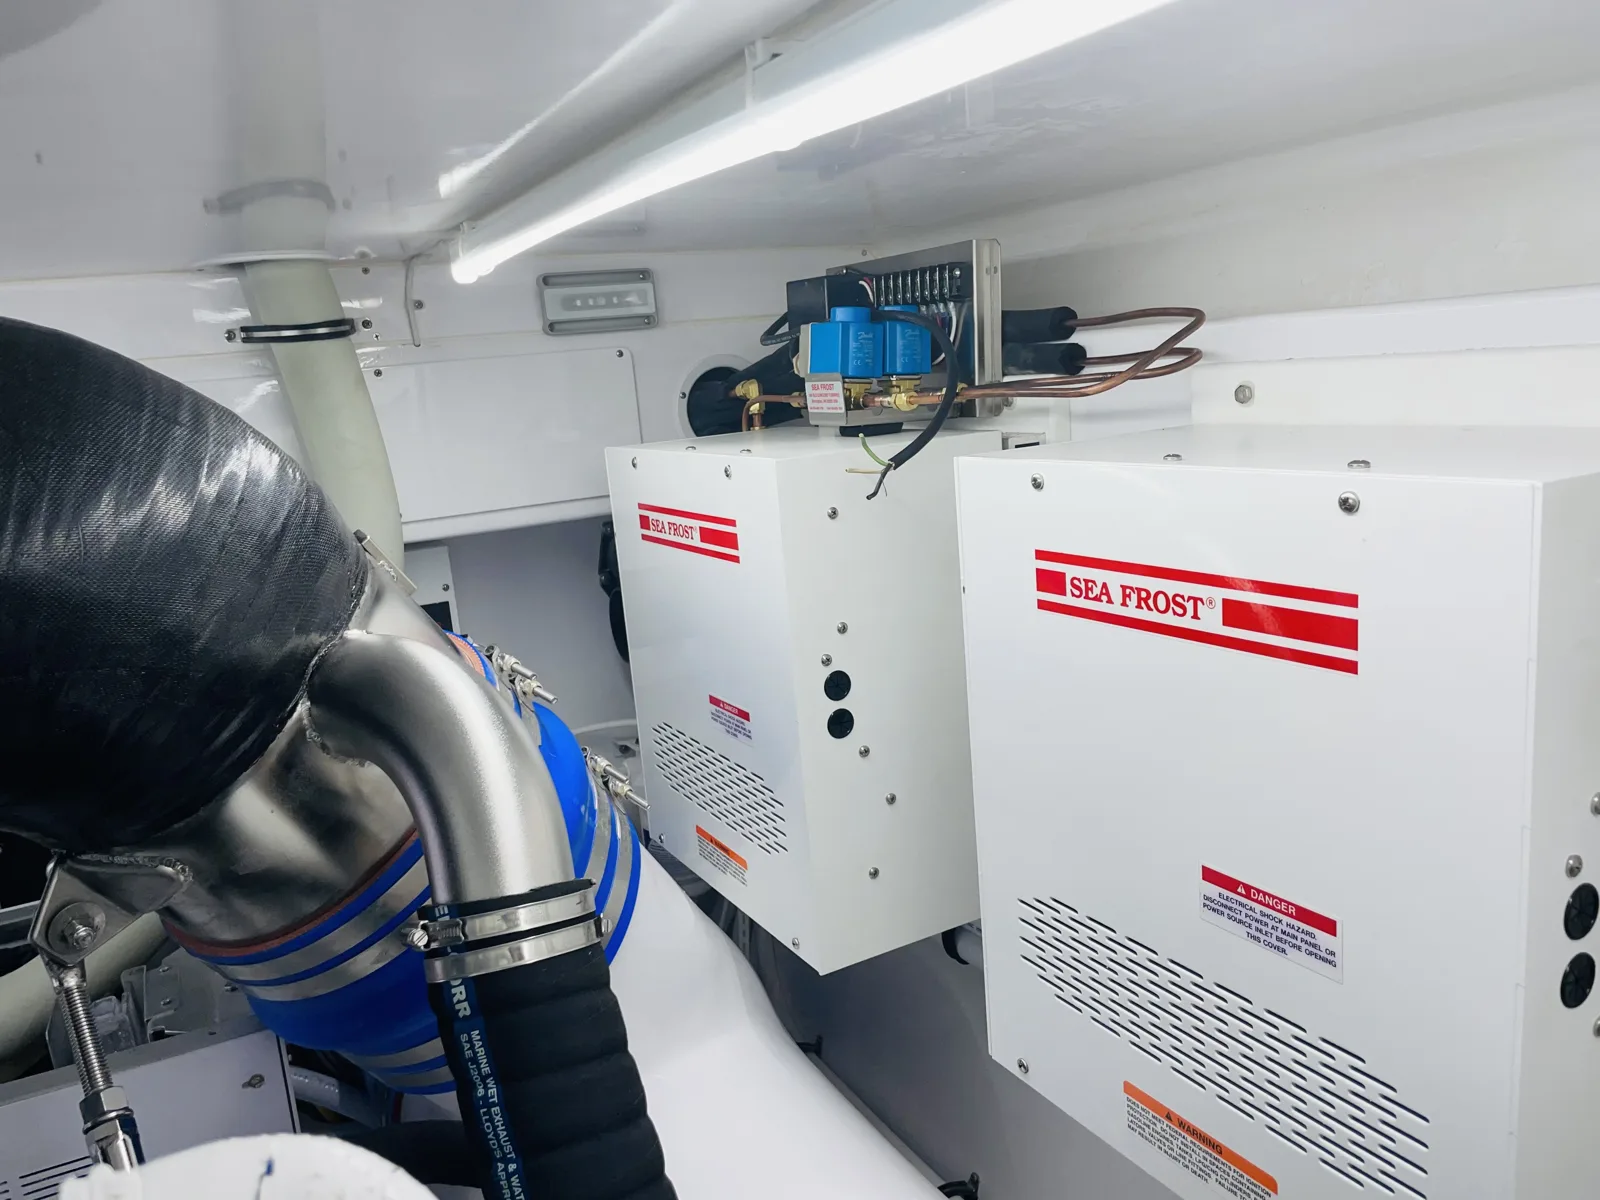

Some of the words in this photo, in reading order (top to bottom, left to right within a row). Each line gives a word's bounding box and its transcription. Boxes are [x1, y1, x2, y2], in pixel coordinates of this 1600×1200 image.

[651, 518, 666, 534] SEA
[1070, 576, 1114, 605] SEA
[1203, 894, 1242, 917] DISCONNECT
[1245, 912, 1268, 929] POWER
[1271, 924, 1278, 933] AT
[1281, 928, 1298, 942] MAIN
[1301, 937, 1322, 952] PANEL
[1325, 948, 1336, 959] OR
[1219, 892, 1257, 916] ELECTRICAL
[1260, 910, 1283, 928] SHOCK
[1286, 921, 1317, 941] HAZARD.
[1251, 889, 1296, 917] DANGER
[1203, 902, 1225, 918] POWER
[1227, 913, 1252, 930] SOURCE
[1255, 926, 1273, 940] INLET
[1276, 935, 1302, 953] BEFORE
[1305, 948, 1336, 969] OPENING
[1246, 931, 1261, 945] THIS
[1263, 939, 1288, 956] COVER.
[470, 1030, 491, 1076] MARINE
[486, 1076, 498, 1103] WET
[460, 1033, 474, 1059] SAE
[468, 1062, 485, 1097] J2006
[480, 1108, 502, 1158] LLOYD'S
[496, 1162, 512, 1200] APPR
[491, 1106, 516, 1158] EXHAUST
[1127, 1109, 1151, 1131] GASOLINE
[1177, 1118, 1223, 1155] WARNING
[508, 1163, 517, 1173] &
[1127, 1096, 1139, 1109] DOES
[1140, 1106, 1150, 1116] NOT
[1152, 1113, 1164, 1126] MEET
[1166, 1122, 1189, 1143] FEDERAL
[1190, 1139, 1231, 1171] REQUIREMENTS
[1234, 1168, 1244, 1180] FOR
[1246, 1176, 1272, 1199] IGNITION
[1128, 1122, 1137, 1134] MAY
[1138, 1130, 1156, 1147] RESULT
[1158, 1143, 1162, 1151] IN
[1163, 1148, 1181, 1165] INJURY
[1182, 1161, 1190, 1171] OR
[1148, 1130, 1166, 1148] VALVES
[1167, 1144, 1174, 1153] OR
[1176, 1150, 1187, 1162] LINE
[1215, 1177, 1238, 1198] FAILURE
[1161, 1126, 1167, 1135] DO
[1169, 1131, 1179, 1143] NOT
[1180, 1140, 1201, 1158] INSTALL
[1209, 1159, 1230, 1178] SPACES
